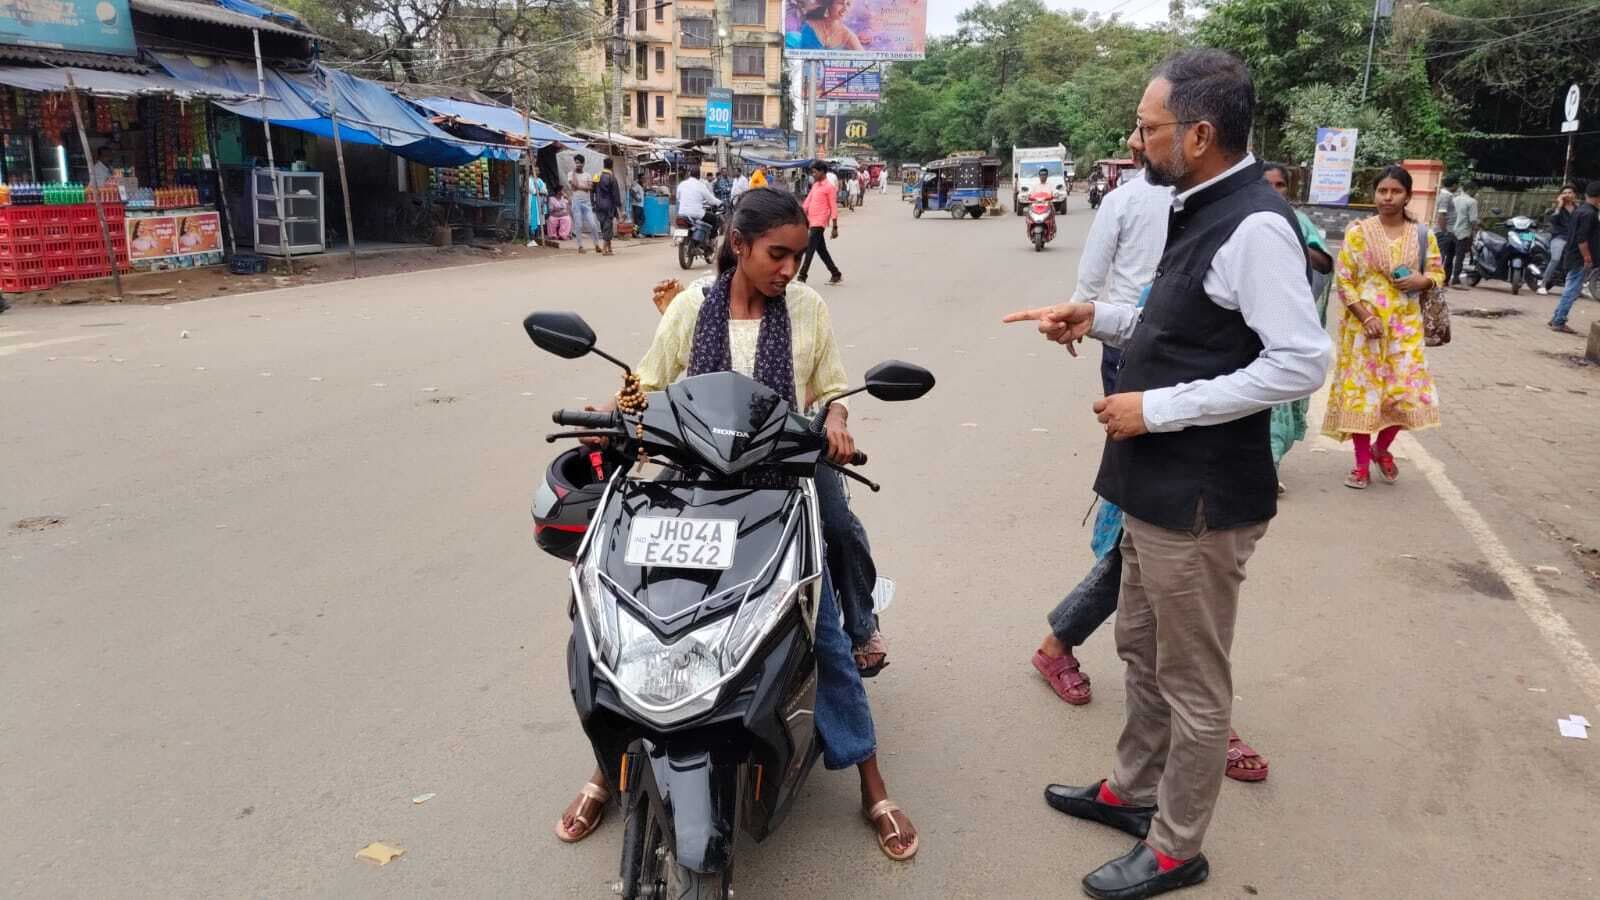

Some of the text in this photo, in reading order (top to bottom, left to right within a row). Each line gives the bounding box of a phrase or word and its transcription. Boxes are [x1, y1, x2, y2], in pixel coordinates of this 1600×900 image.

[708, 107, 729, 122] 300
[712, 427, 750, 438] HONDA
[650, 519, 722, 543] JH04A
[645, 541, 720, 566] E4542
